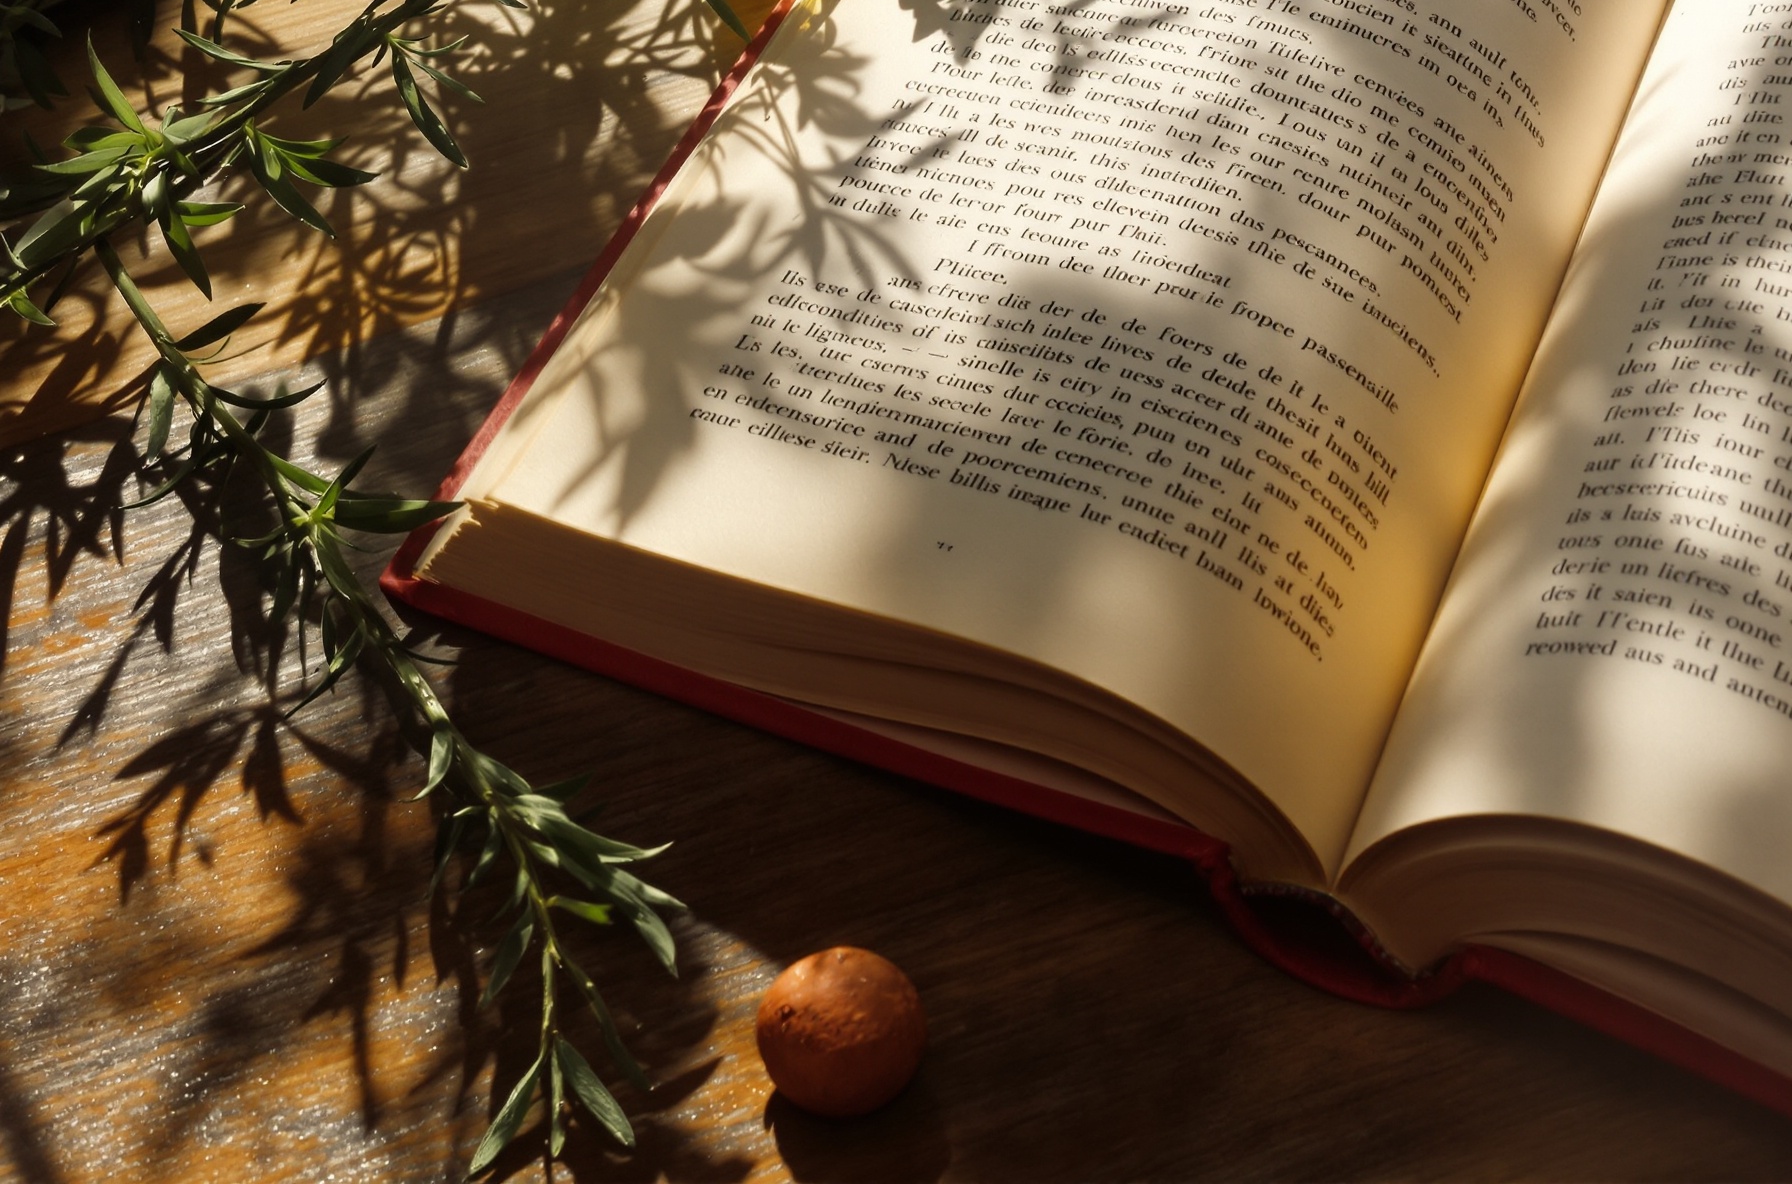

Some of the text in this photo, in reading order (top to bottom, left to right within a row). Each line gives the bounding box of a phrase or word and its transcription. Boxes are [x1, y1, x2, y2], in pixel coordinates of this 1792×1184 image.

[1294, 73, 1325, 93] the
[1368, 104, 1399, 125] me
[1375, 129, 1400, 149] de
[1404, 148, 1416, 163] a
[1089, 152, 1127, 171] this
[1180, 150, 1215, 169] des
[1249, 151, 1286, 169] our
[1721, 253, 1739, 266] is
[1720, 274, 1741, 288] in
[1038, 299, 1071, 318] der
[1080, 307, 1107, 325] de
[1120, 317, 1147, 335] de
[1221, 351, 1247, 369] de
[1257, 365, 1283, 385] de
[1333, 414, 1346, 429] a
[1083, 355, 1110, 373] de
[1165, 354, 1192, 372] de
[1109, 385, 1132, 403] in
[1611, 385, 1633, 398] as
[1689, 379, 1748, 401] there
[702, 385, 728, 400] en
[872, 430, 918, 448] and
[926, 439, 954, 457] de
[1020, 437, 1048, 455] de
[1673, 664, 1719, 682] and
